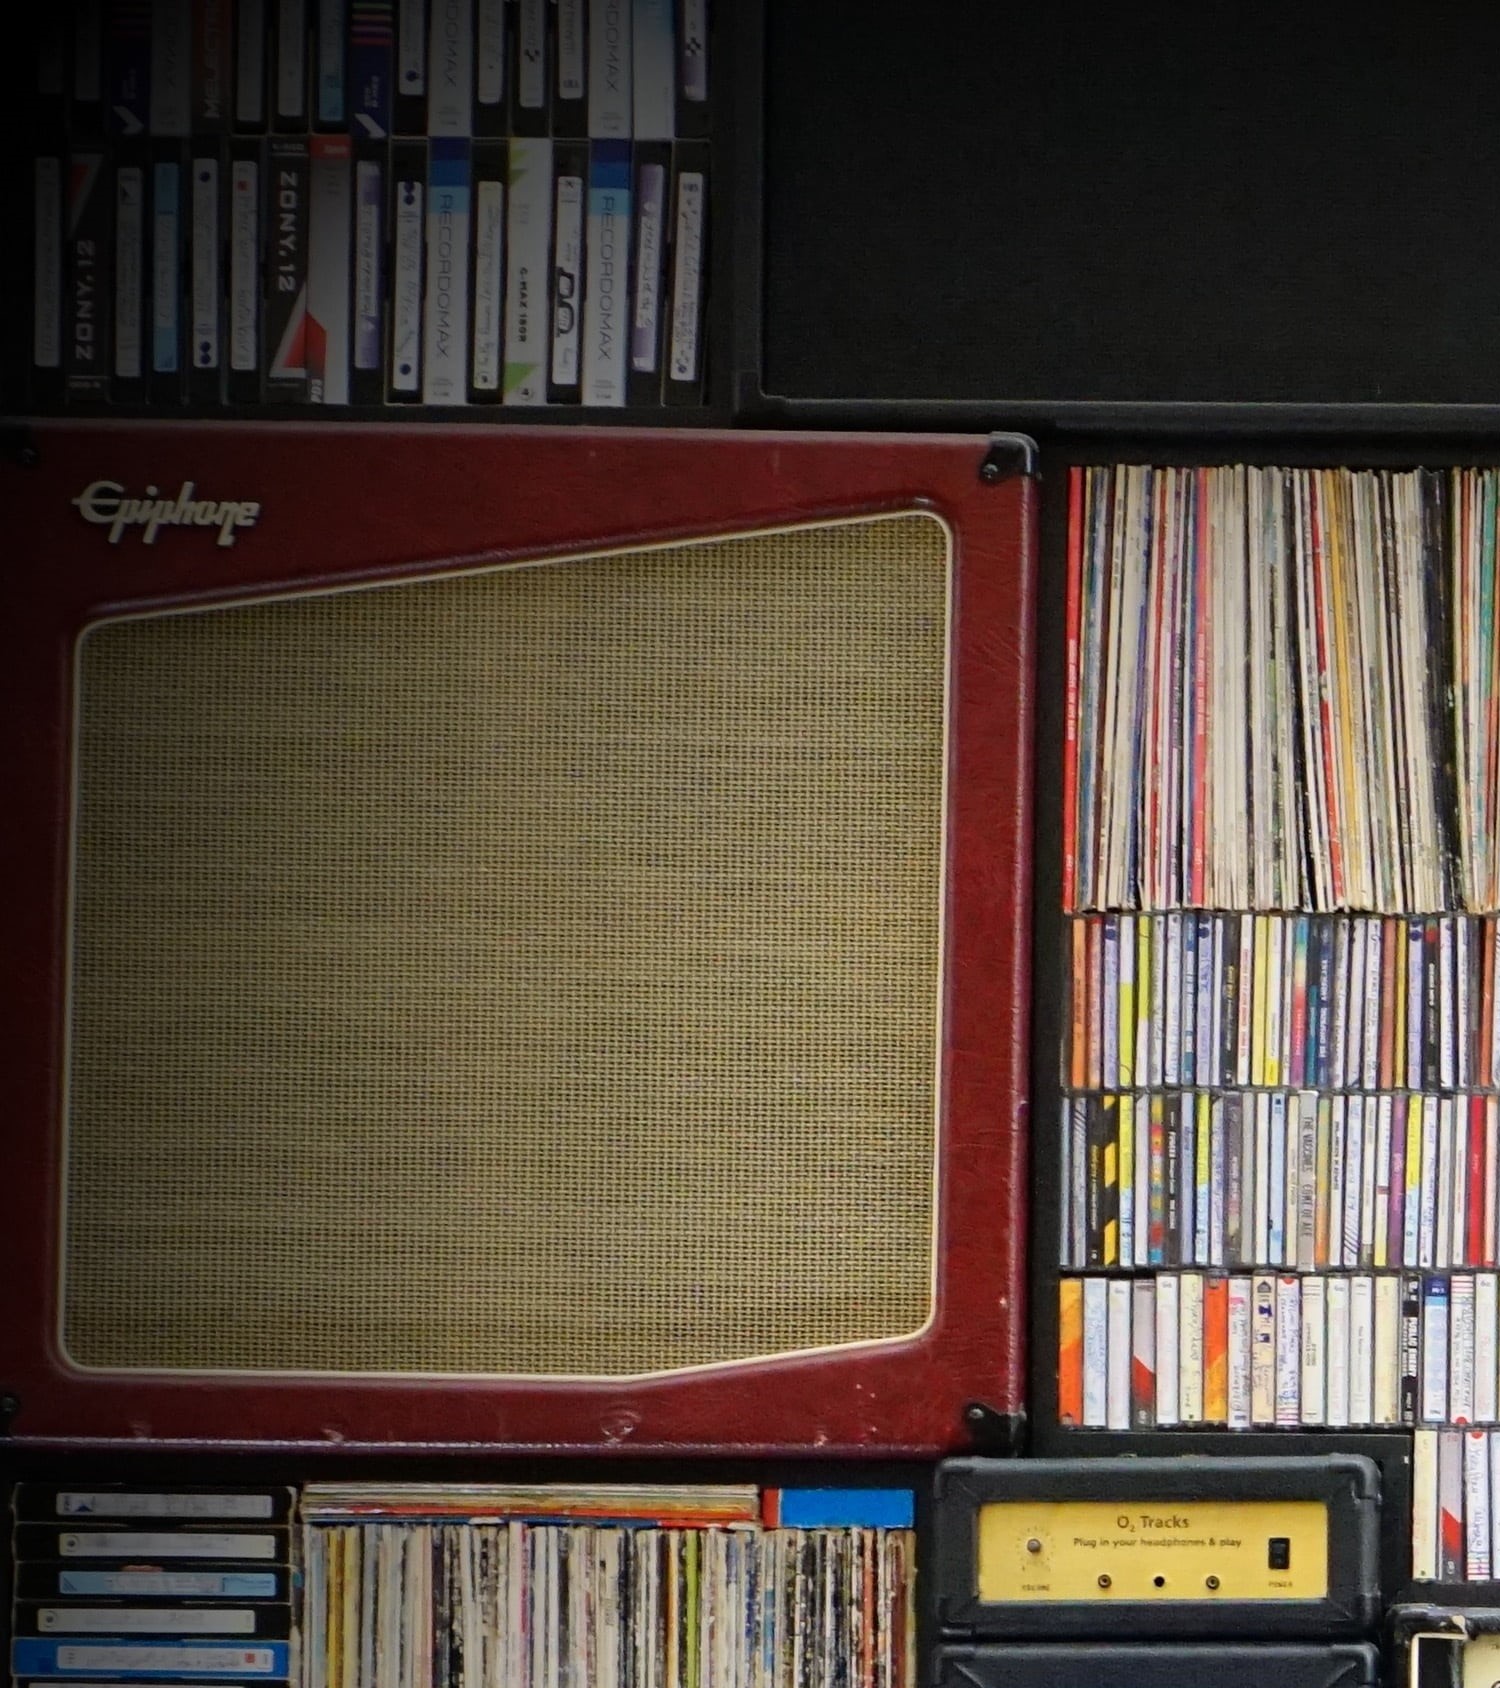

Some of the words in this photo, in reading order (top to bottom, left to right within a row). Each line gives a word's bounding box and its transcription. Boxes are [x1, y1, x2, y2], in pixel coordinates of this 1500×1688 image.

[436, 194, 454, 358] RECORDOMAX
[598, 196, 615, 360] RECORDOMAX
[72, 479, 261, 546] Epiphone
[1302, 1116, 1314, 1132] THE
[1302, 1134, 1315, 1173] VACCINES
[1140, 1515, 1190, 1529] Tracks
